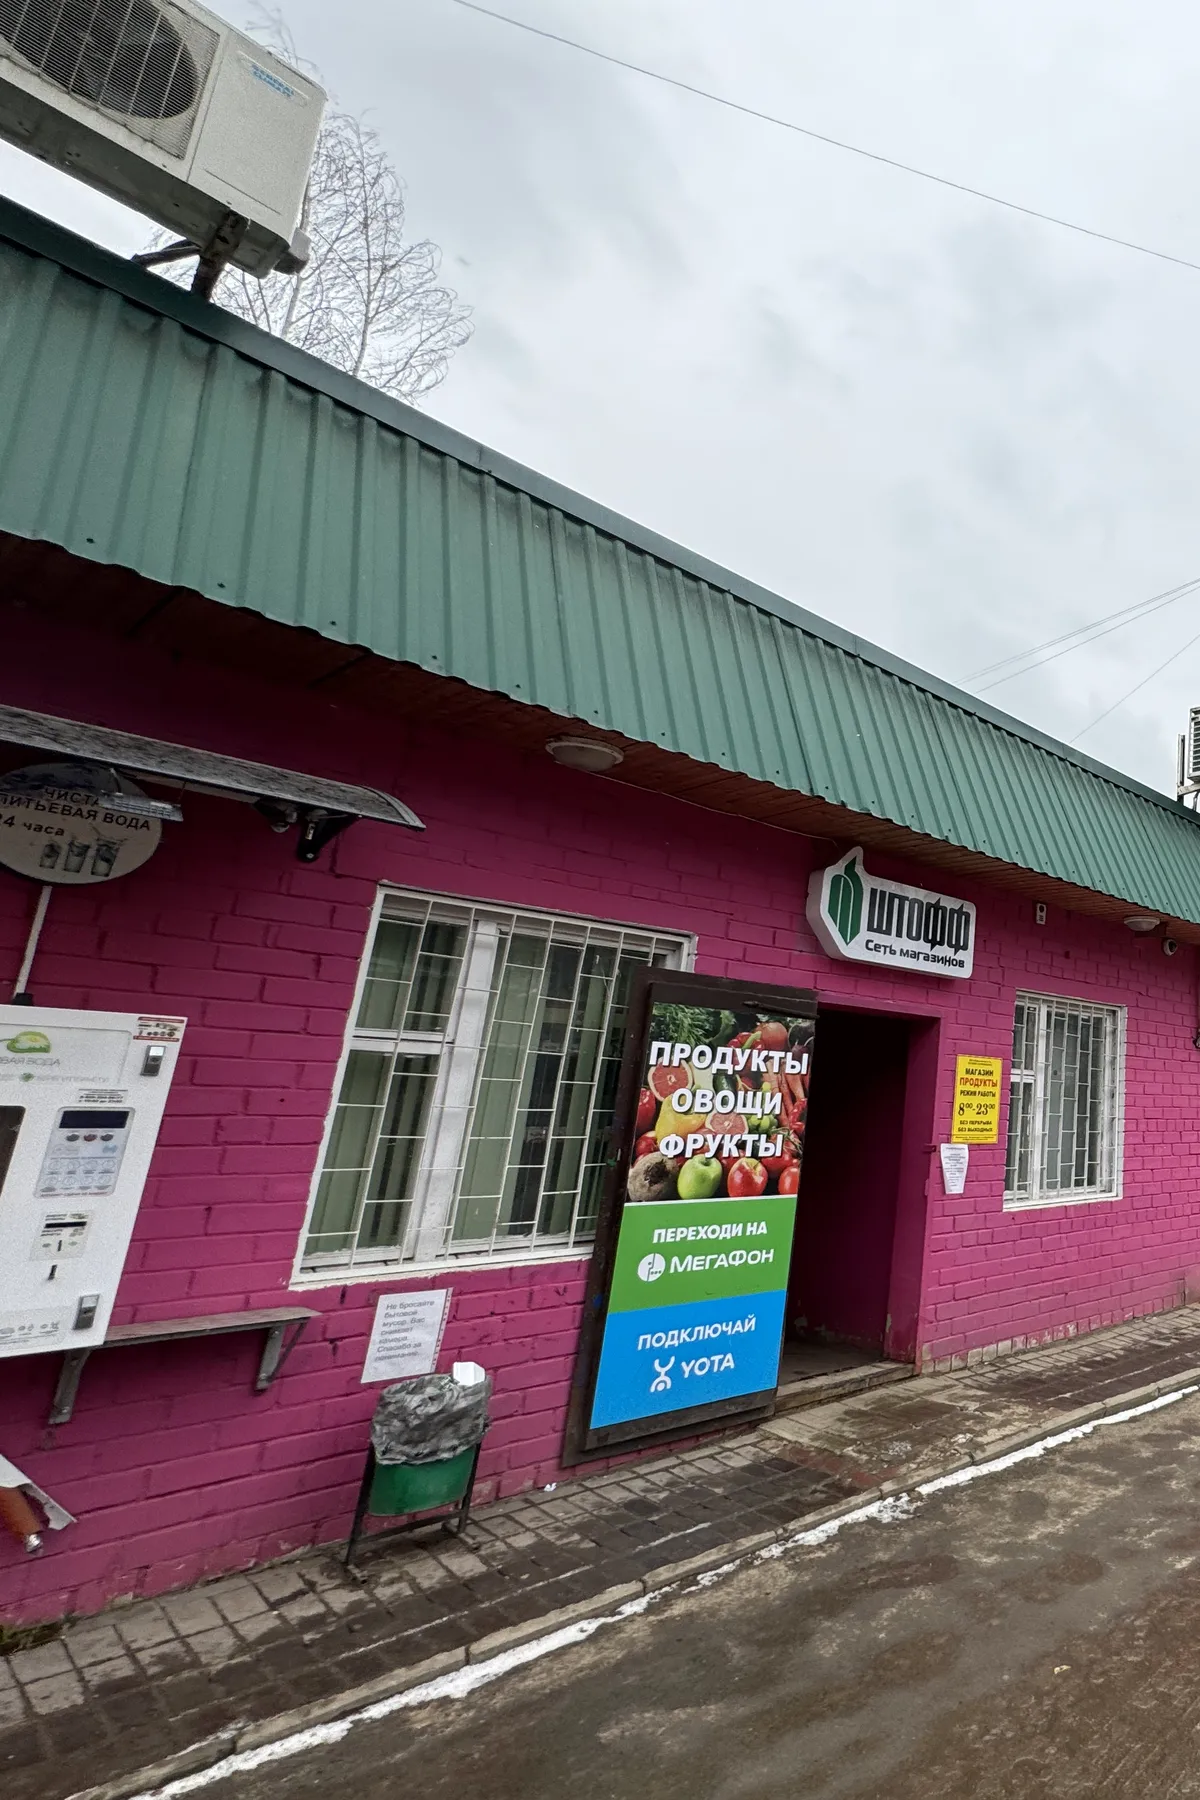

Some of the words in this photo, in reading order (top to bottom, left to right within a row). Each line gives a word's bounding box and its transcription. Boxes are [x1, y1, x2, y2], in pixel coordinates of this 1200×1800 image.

[0, 813, 15, 828] 4
[23, 822, 65, 837] часа
[103, 812, 150, 830] ВОДА
[867, 887, 971, 956] ШТОФФ
[865, 939, 897, 955] Сеть
[899, 948, 965, 968] магазинов
[649, 1041, 809, 1075] ПРОДУКТЫ
[960, 1077, 998, 1088] ПРОДУКТЫ
[965, 1068, 994, 1077] МАГАЗИН
[671, 1088, 782, 1118] ОВОЩИ
[977, 1090, 996, 1098] РАБОТЫ
[659, 1133, 783, 1158] ФРУКТЫ
[652, 1223, 743, 1244] ПЕРЕХОДИ
[746, 1221, 768, 1236] НА
[669, 1249, 775, 1274] МЕГАФОН
[638, 1313, 757, 1350] ПОДКЛЮЧАЙ
[680, 1352, 735, 1378] YOTA
